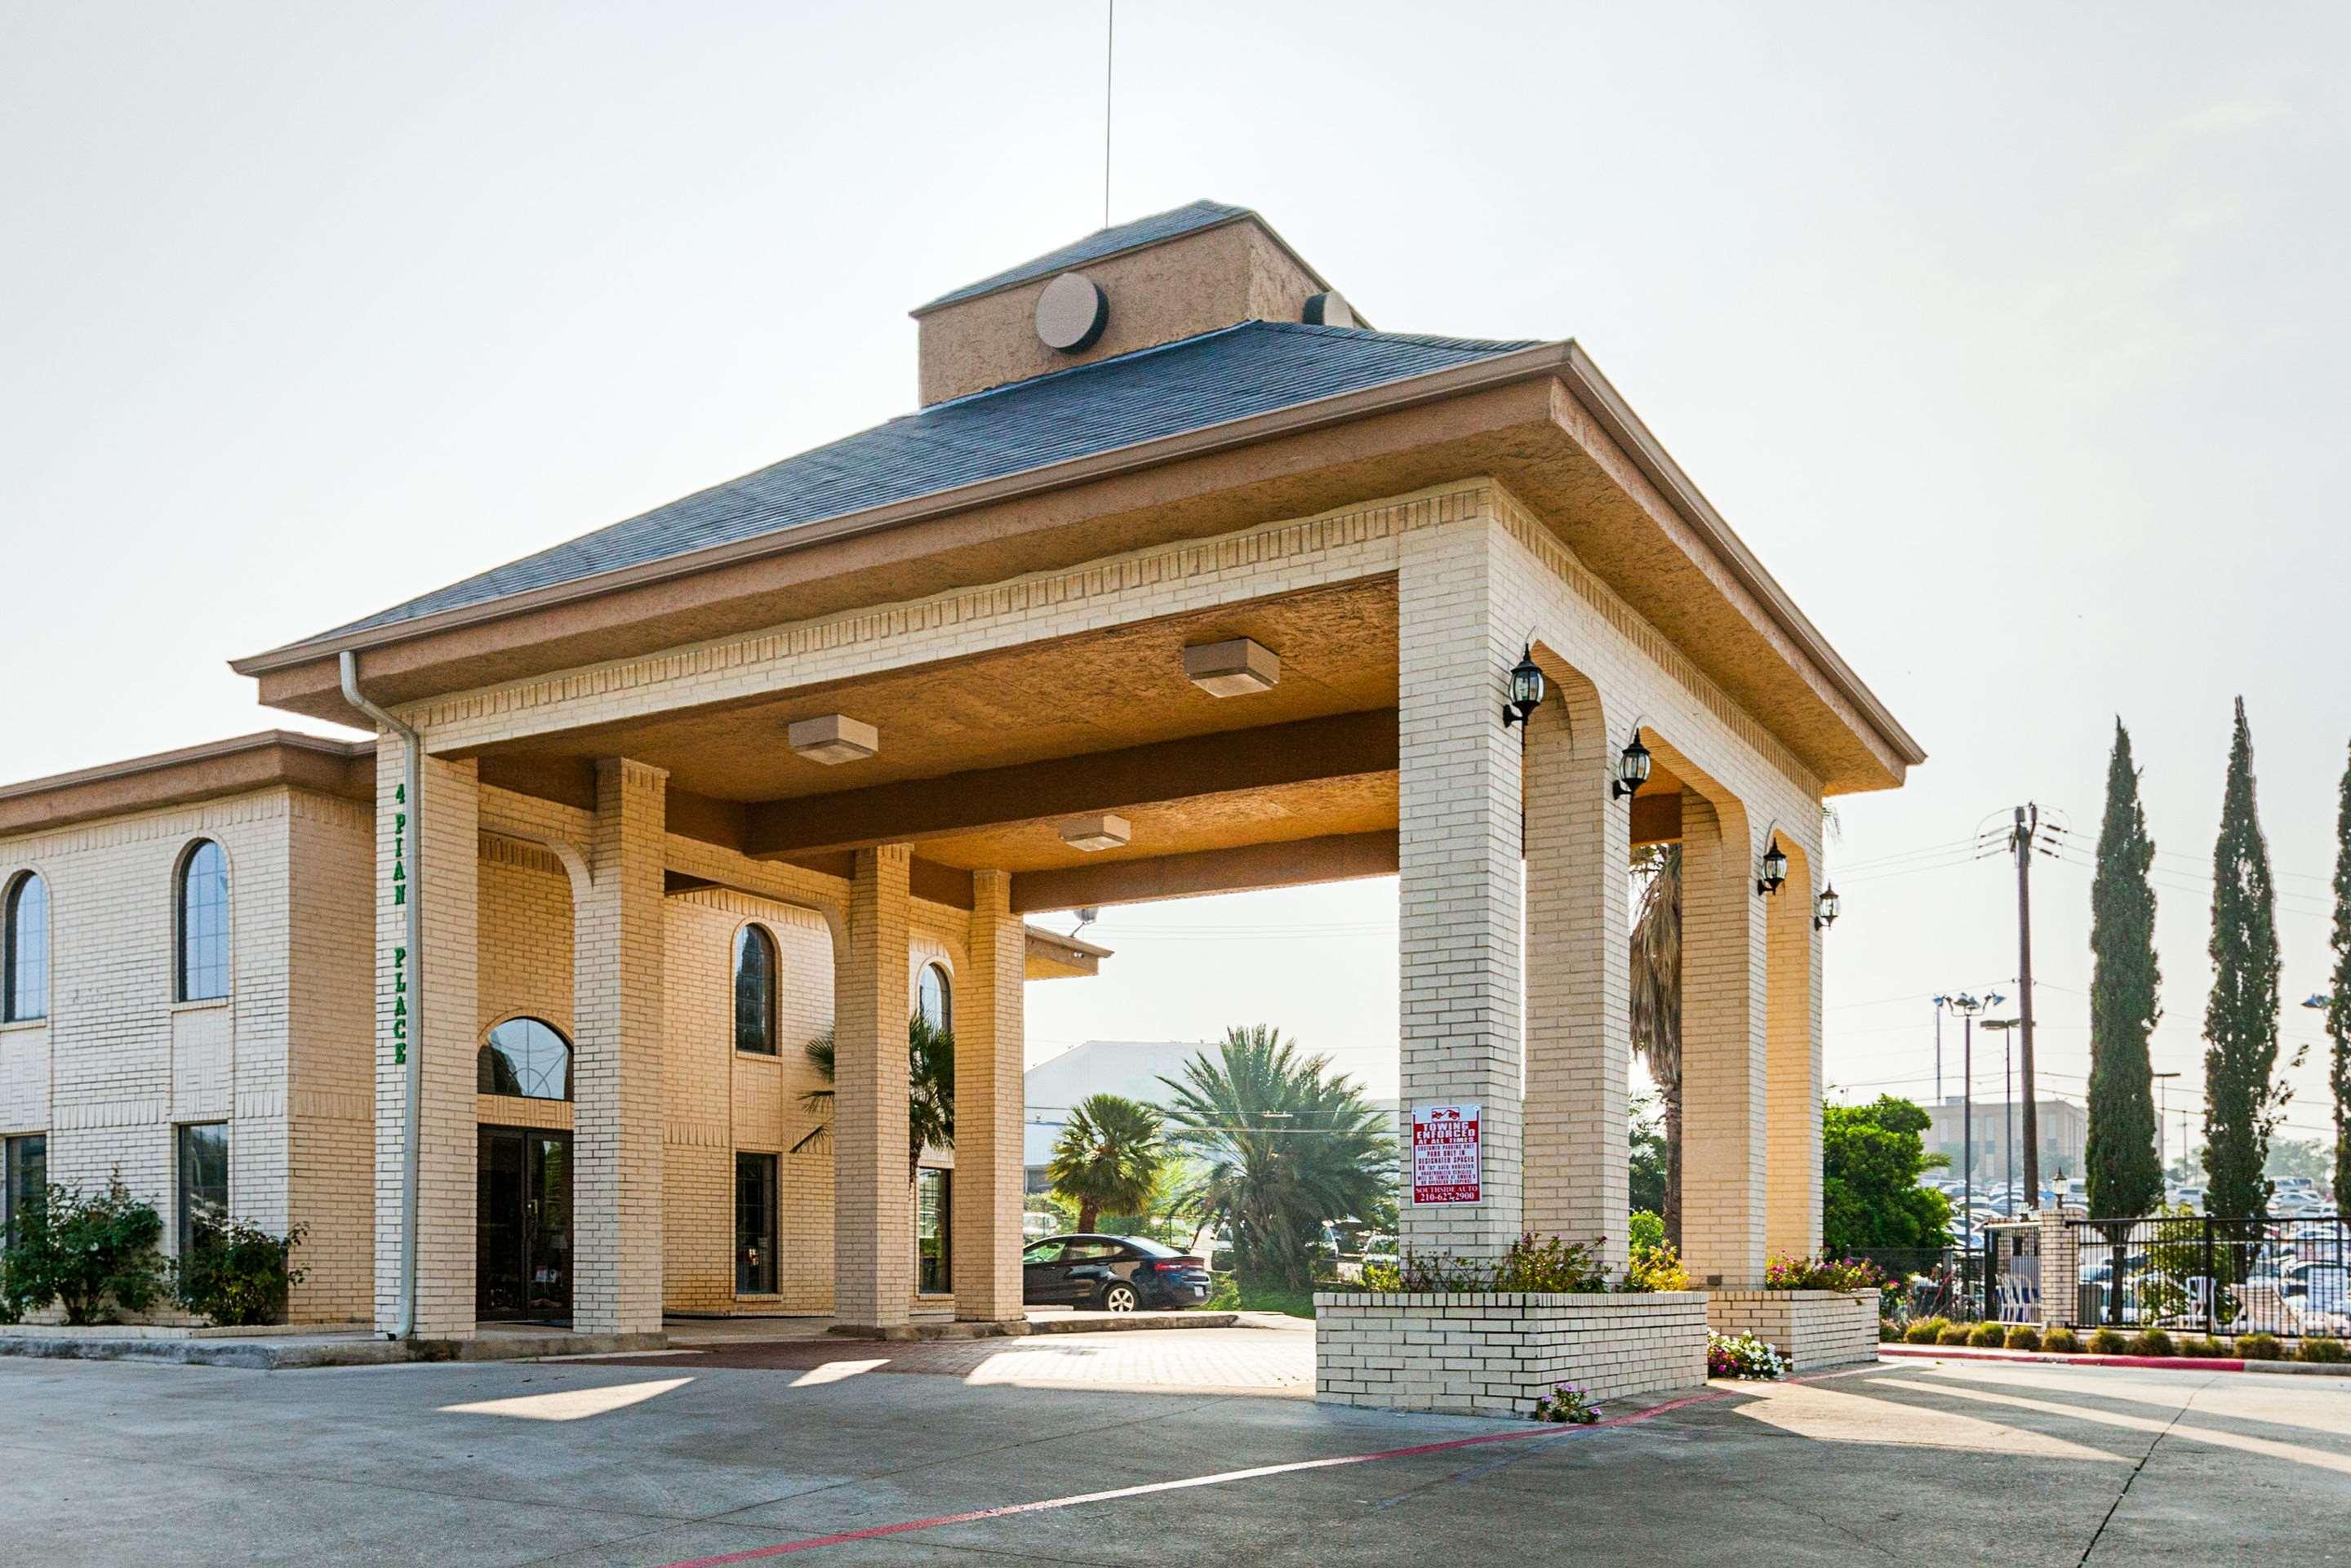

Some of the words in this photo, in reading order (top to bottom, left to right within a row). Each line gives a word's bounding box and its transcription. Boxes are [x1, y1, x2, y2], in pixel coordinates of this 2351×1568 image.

[395, 784, 405, 804] 4
[393, 813, 406, 905] PIAN
[393, 947, 407, 1064] PLACE
[1416, 1129, 1475, 1139] ENFORCED
[1424, 1122, 1469, 1131] TOWING
